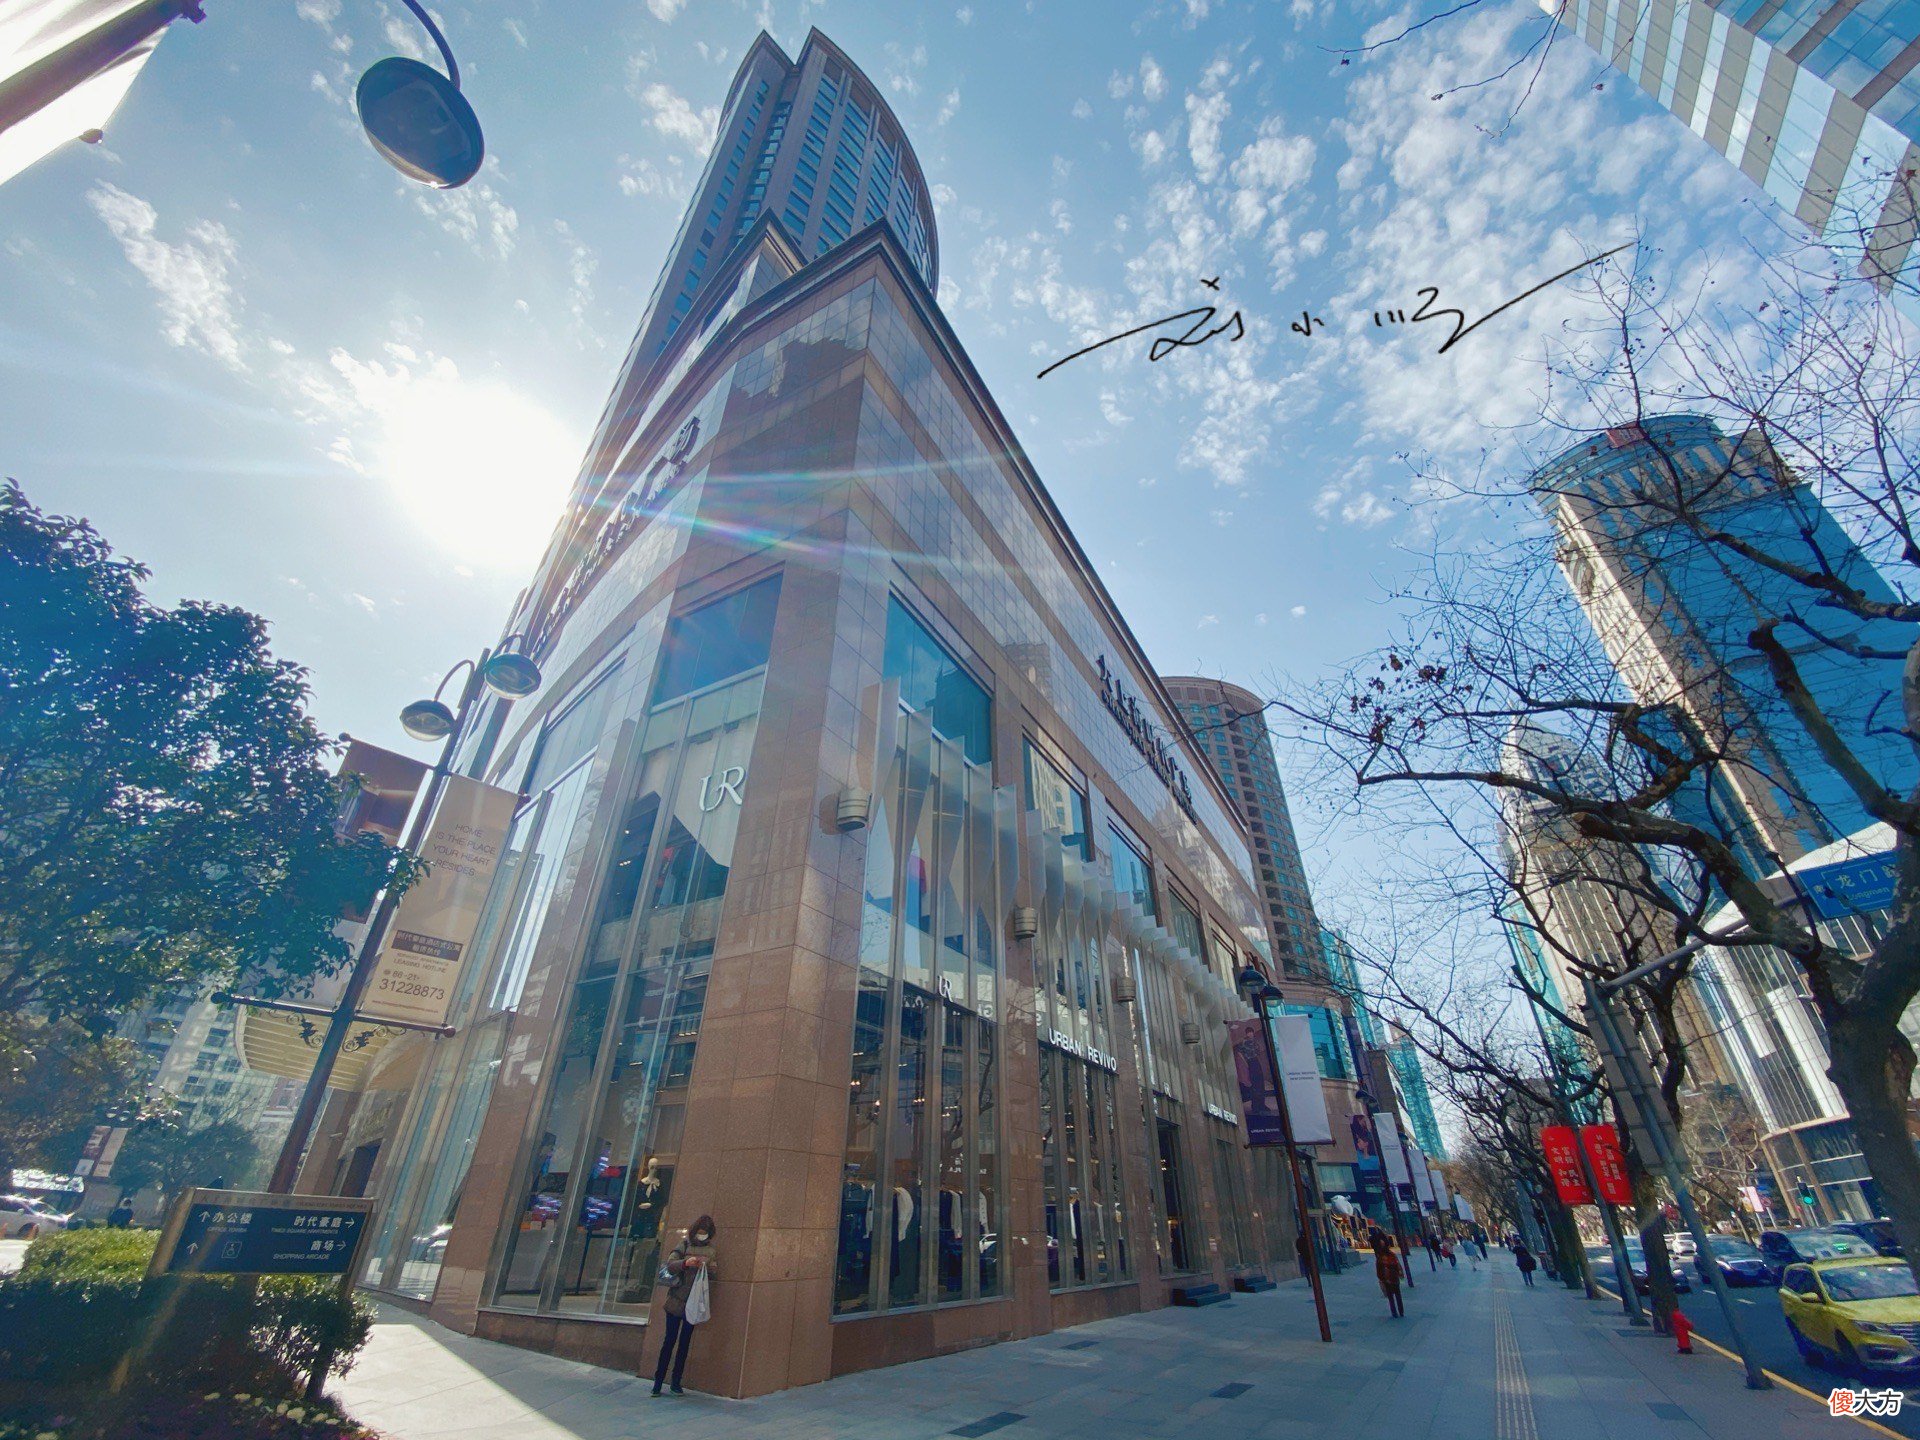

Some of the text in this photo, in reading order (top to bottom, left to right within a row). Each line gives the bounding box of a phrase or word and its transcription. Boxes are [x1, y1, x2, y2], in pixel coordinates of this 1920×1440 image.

[699, 766, 745, 811] UR
[455, 824, 484, 838] HOME
[435, 831, 496, 855] IS THE PLACE
[433, 844, 490, 866] YOUR HEART
[435, 858, 476, 876] RESIDES
[379, 978, 445, 1000] 31228873
[938, 975, 953, 1002] UR
[1048, 1027, 1117, 1072] URBAN REVIVO
[212, 1212, 253, 1225] 办公楼
[310, 1240, 334, 1251] 商场
